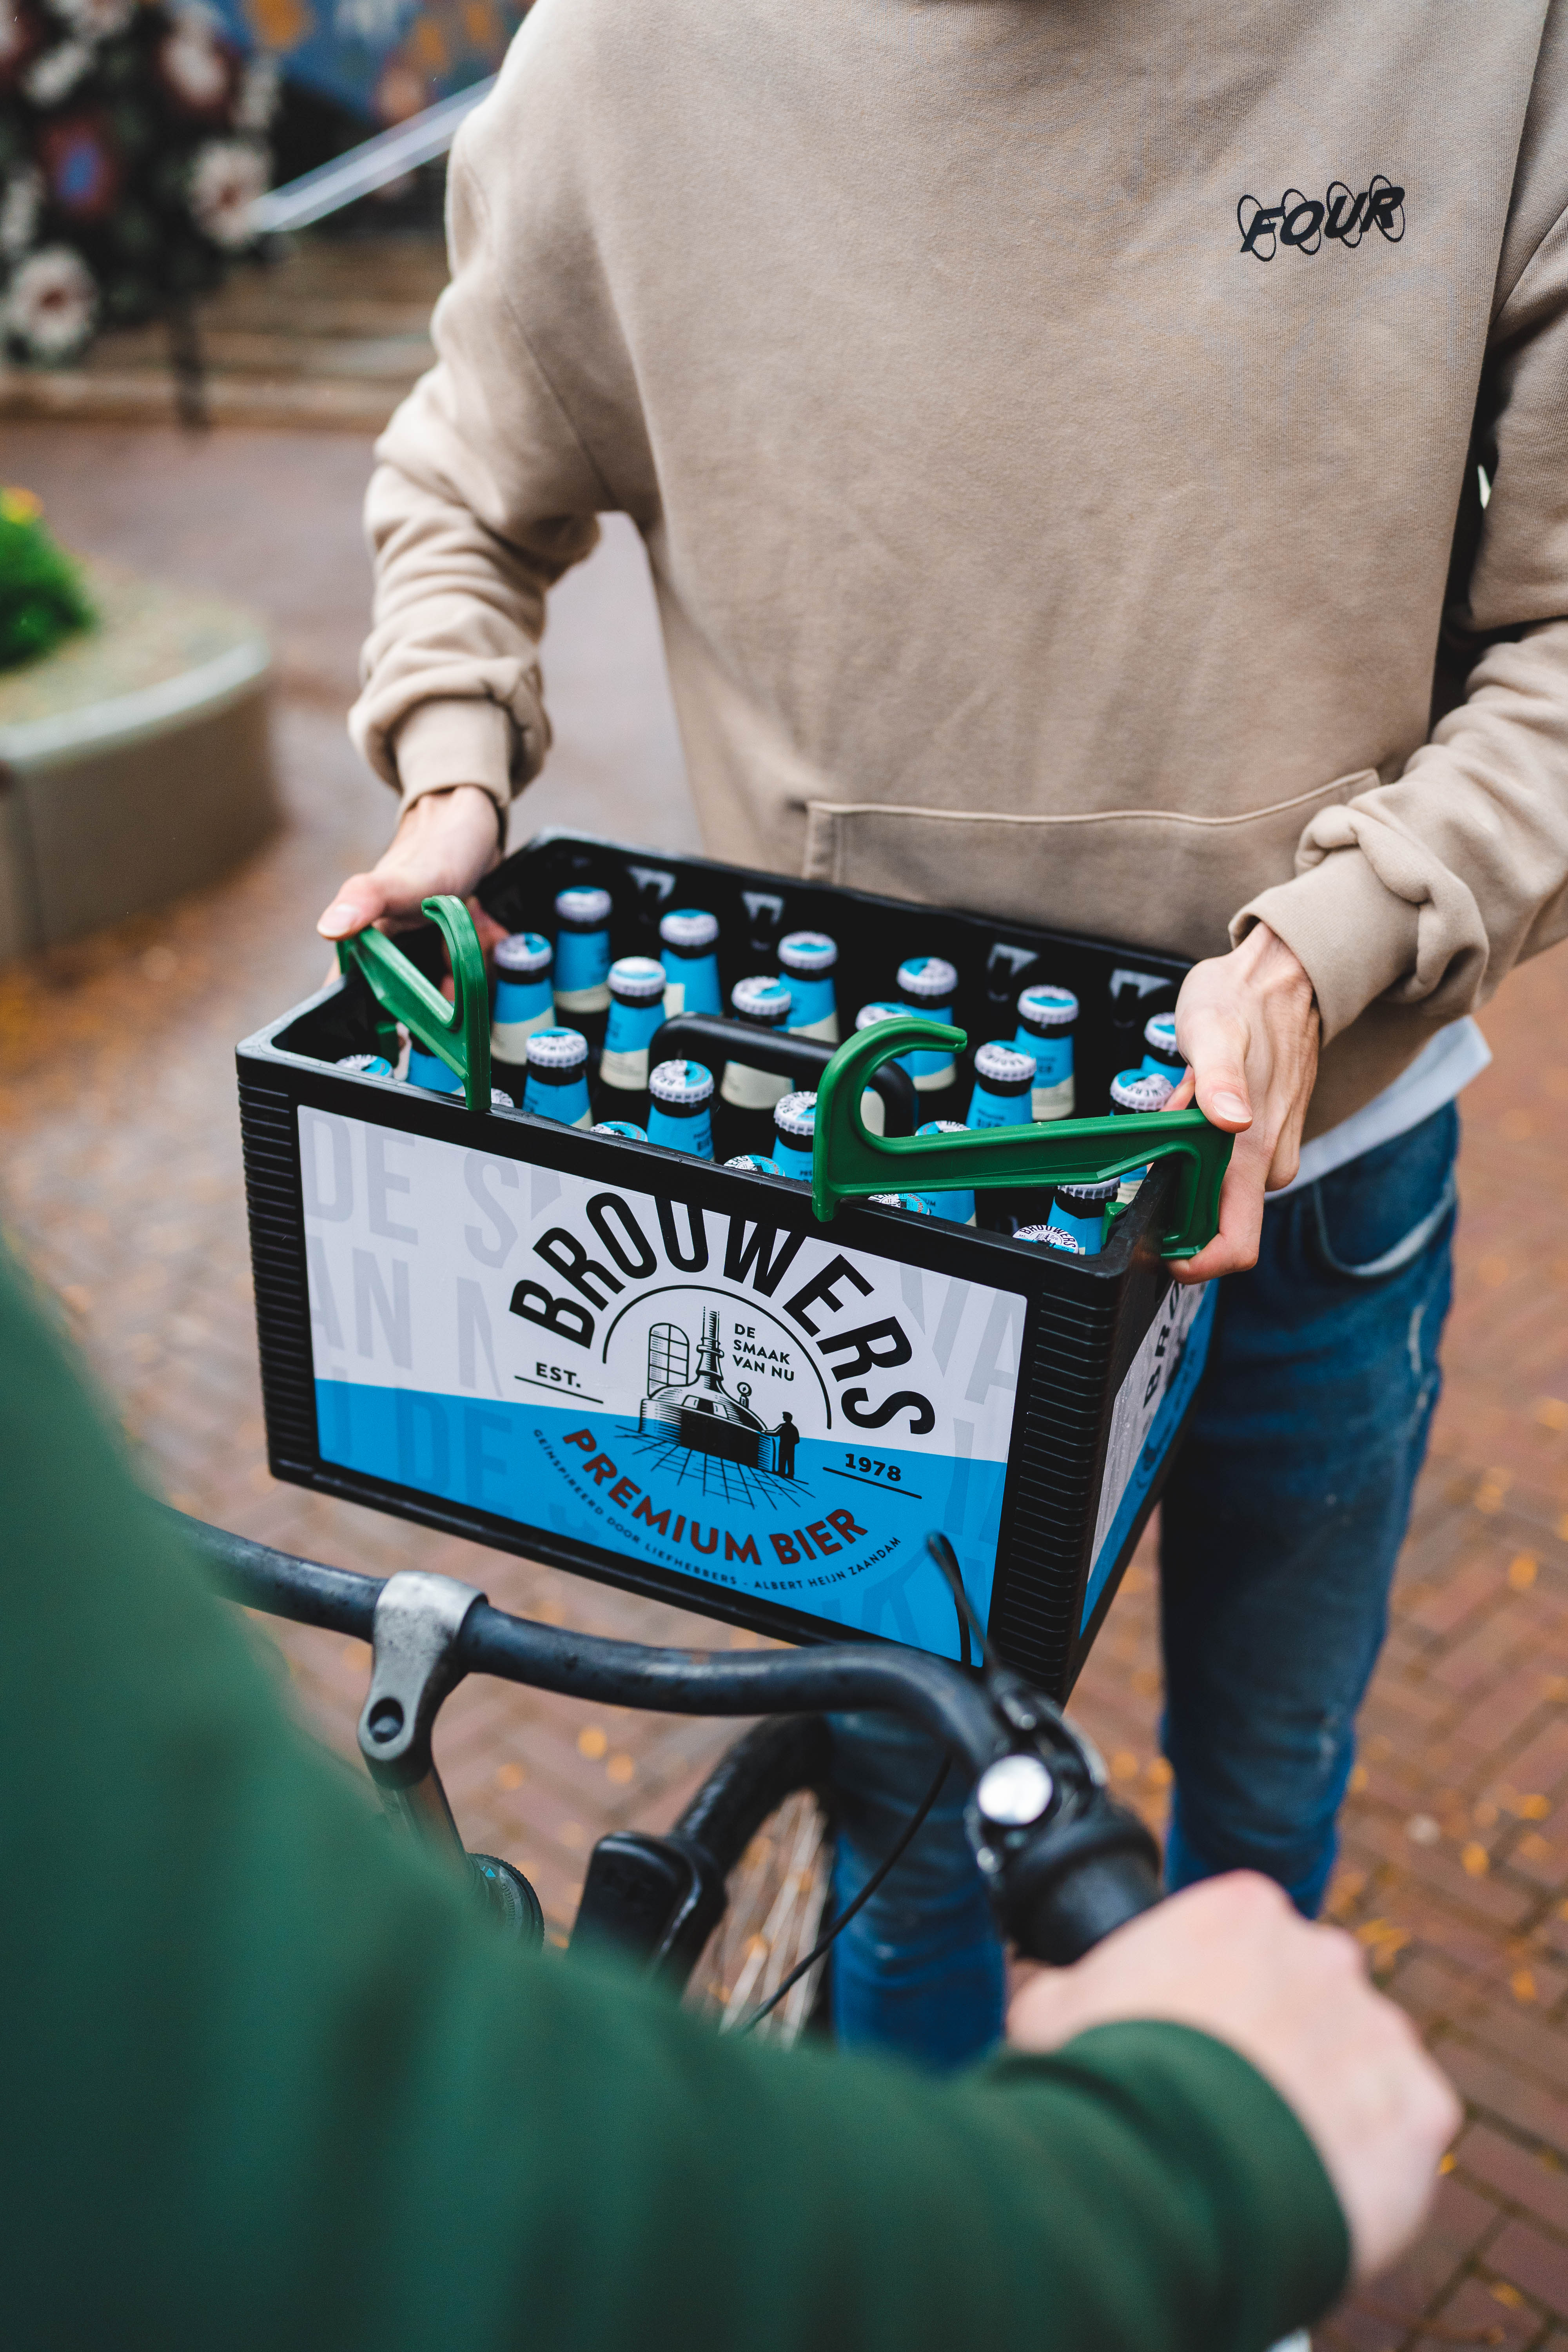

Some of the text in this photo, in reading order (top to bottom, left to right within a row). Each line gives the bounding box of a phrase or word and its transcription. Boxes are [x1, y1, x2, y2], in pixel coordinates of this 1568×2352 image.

[1239, 184, 1405, 255] FOUR
[1019, 1225, 1076, 1248] BROUWERS
[509, 1192, 935, 1435] BROUWERS
[734, 1323, 756, 1339] DE
[733, 1339, 790, 1365] SMAAK
[535, 1361, 581, 1388] EST.
[732, 1354, 795, 1381] VAN NU
[845, 1453, 902, 1482] 1978
[563, 1428, 868, 1566] PREMIUM BIER
[607, 1517, 640, 1543] DOOR
[645, 1543, 737, 1585] LIEFHEBBERS
[754, 1579, 804, 1590] ALBERT
[808, 1570, 846, 1588] HEIJN
[848, 1536, 901, 1576] ZAANDAM
